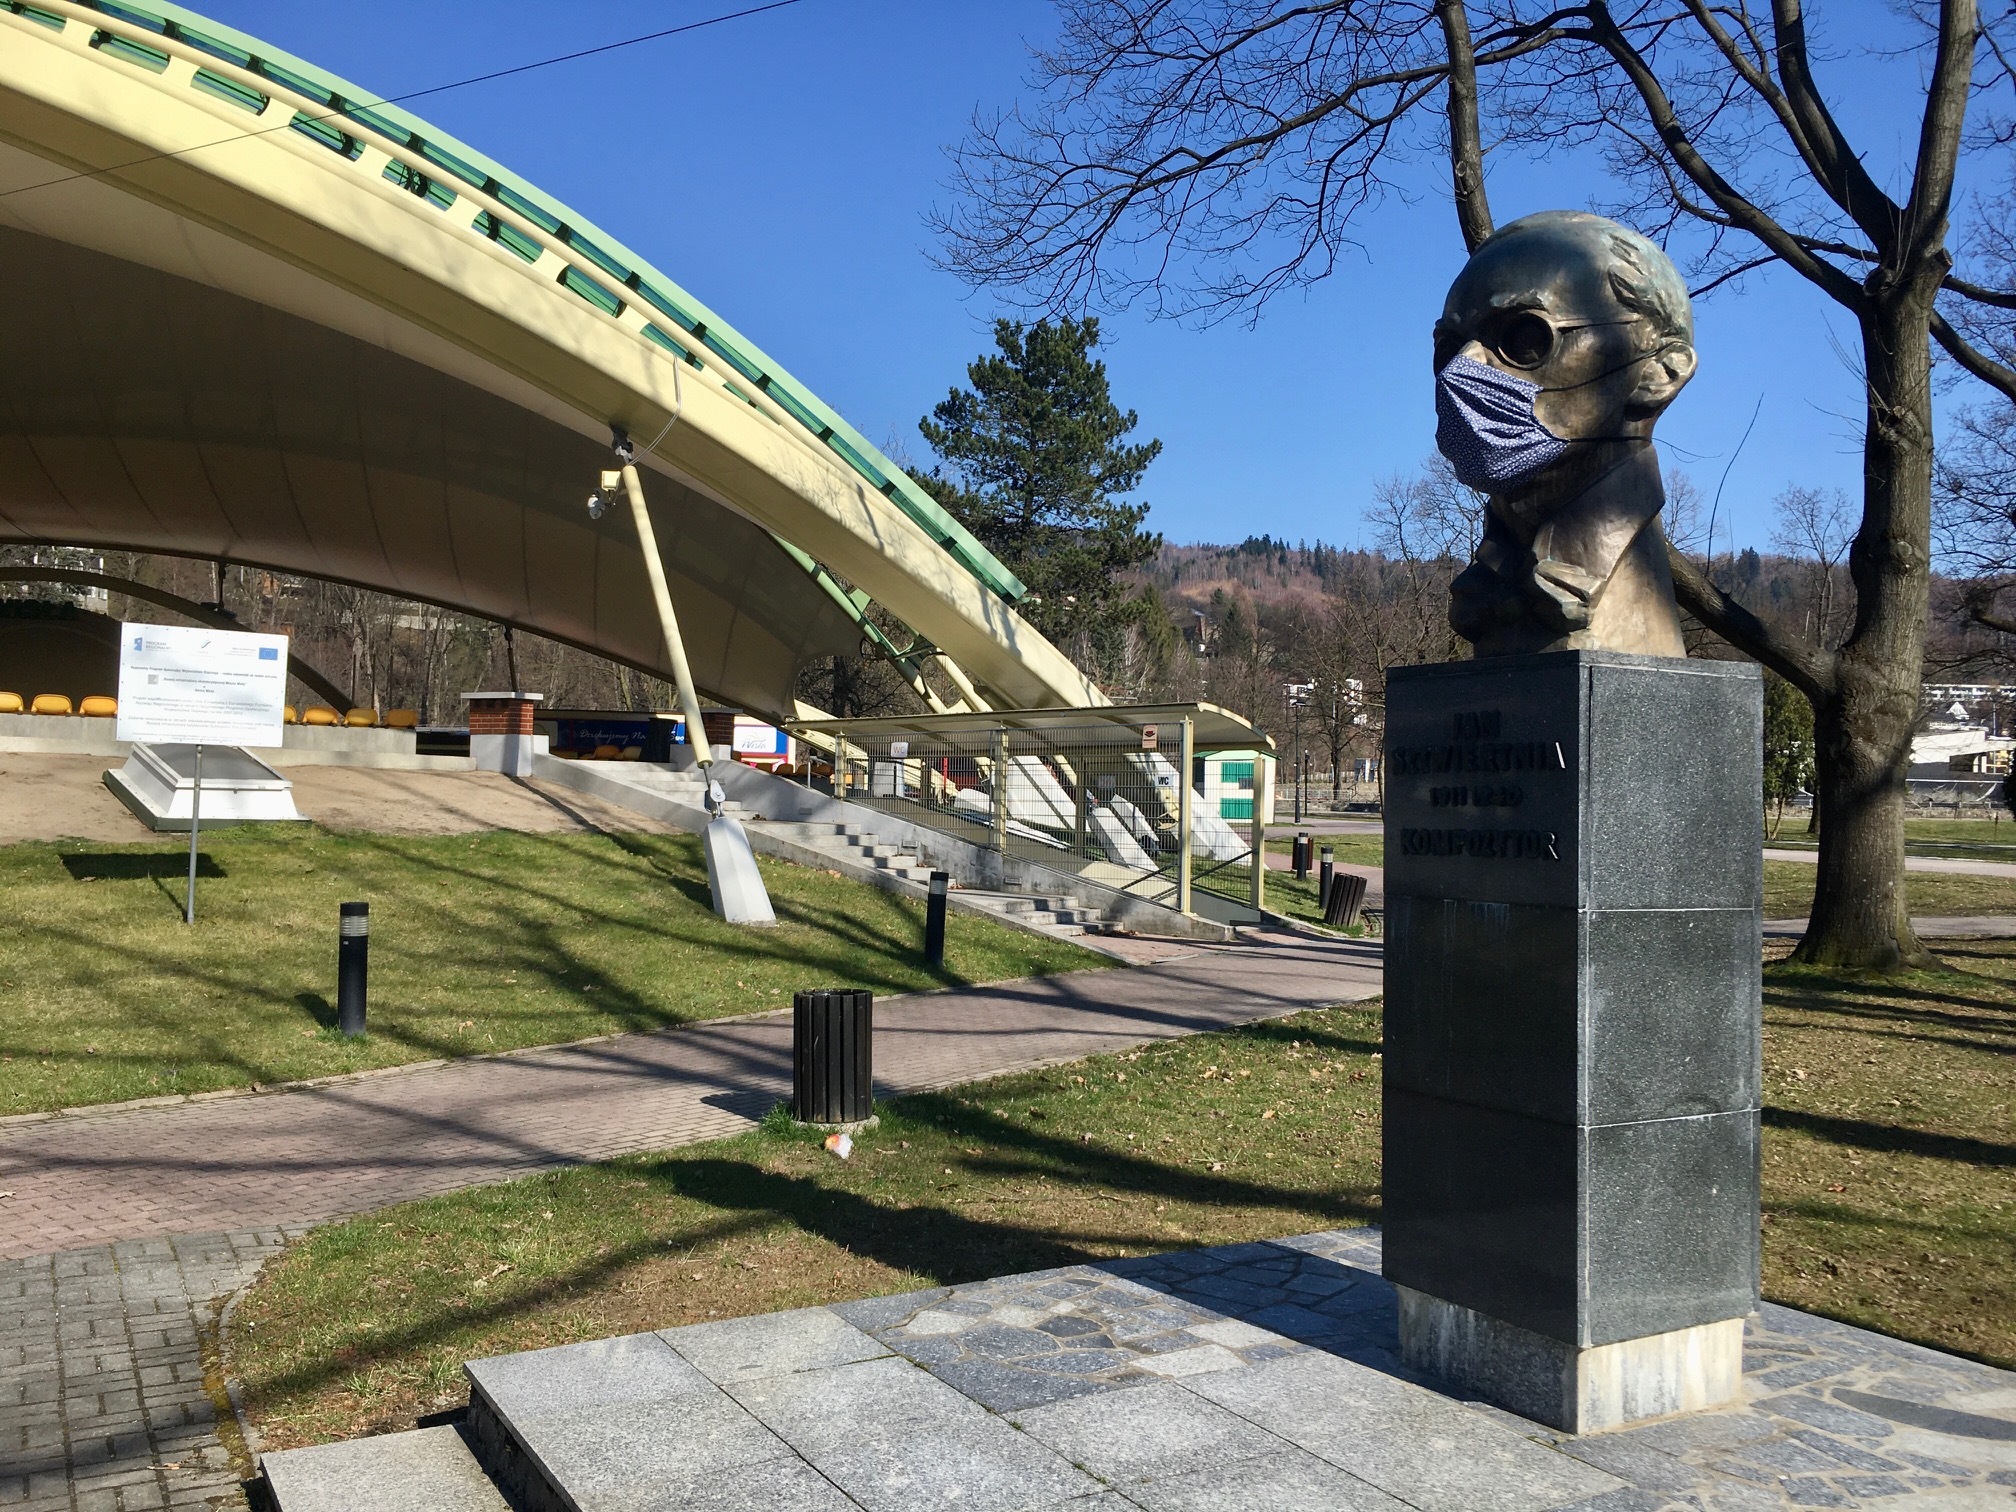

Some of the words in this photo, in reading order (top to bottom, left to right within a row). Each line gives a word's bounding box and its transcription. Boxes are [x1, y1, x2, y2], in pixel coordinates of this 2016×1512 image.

[893, 746, 906, 754] WC
[1157, 776, 1169, 786] WC
[1400, 827, 1561, 862] KOMPOZYTOR
